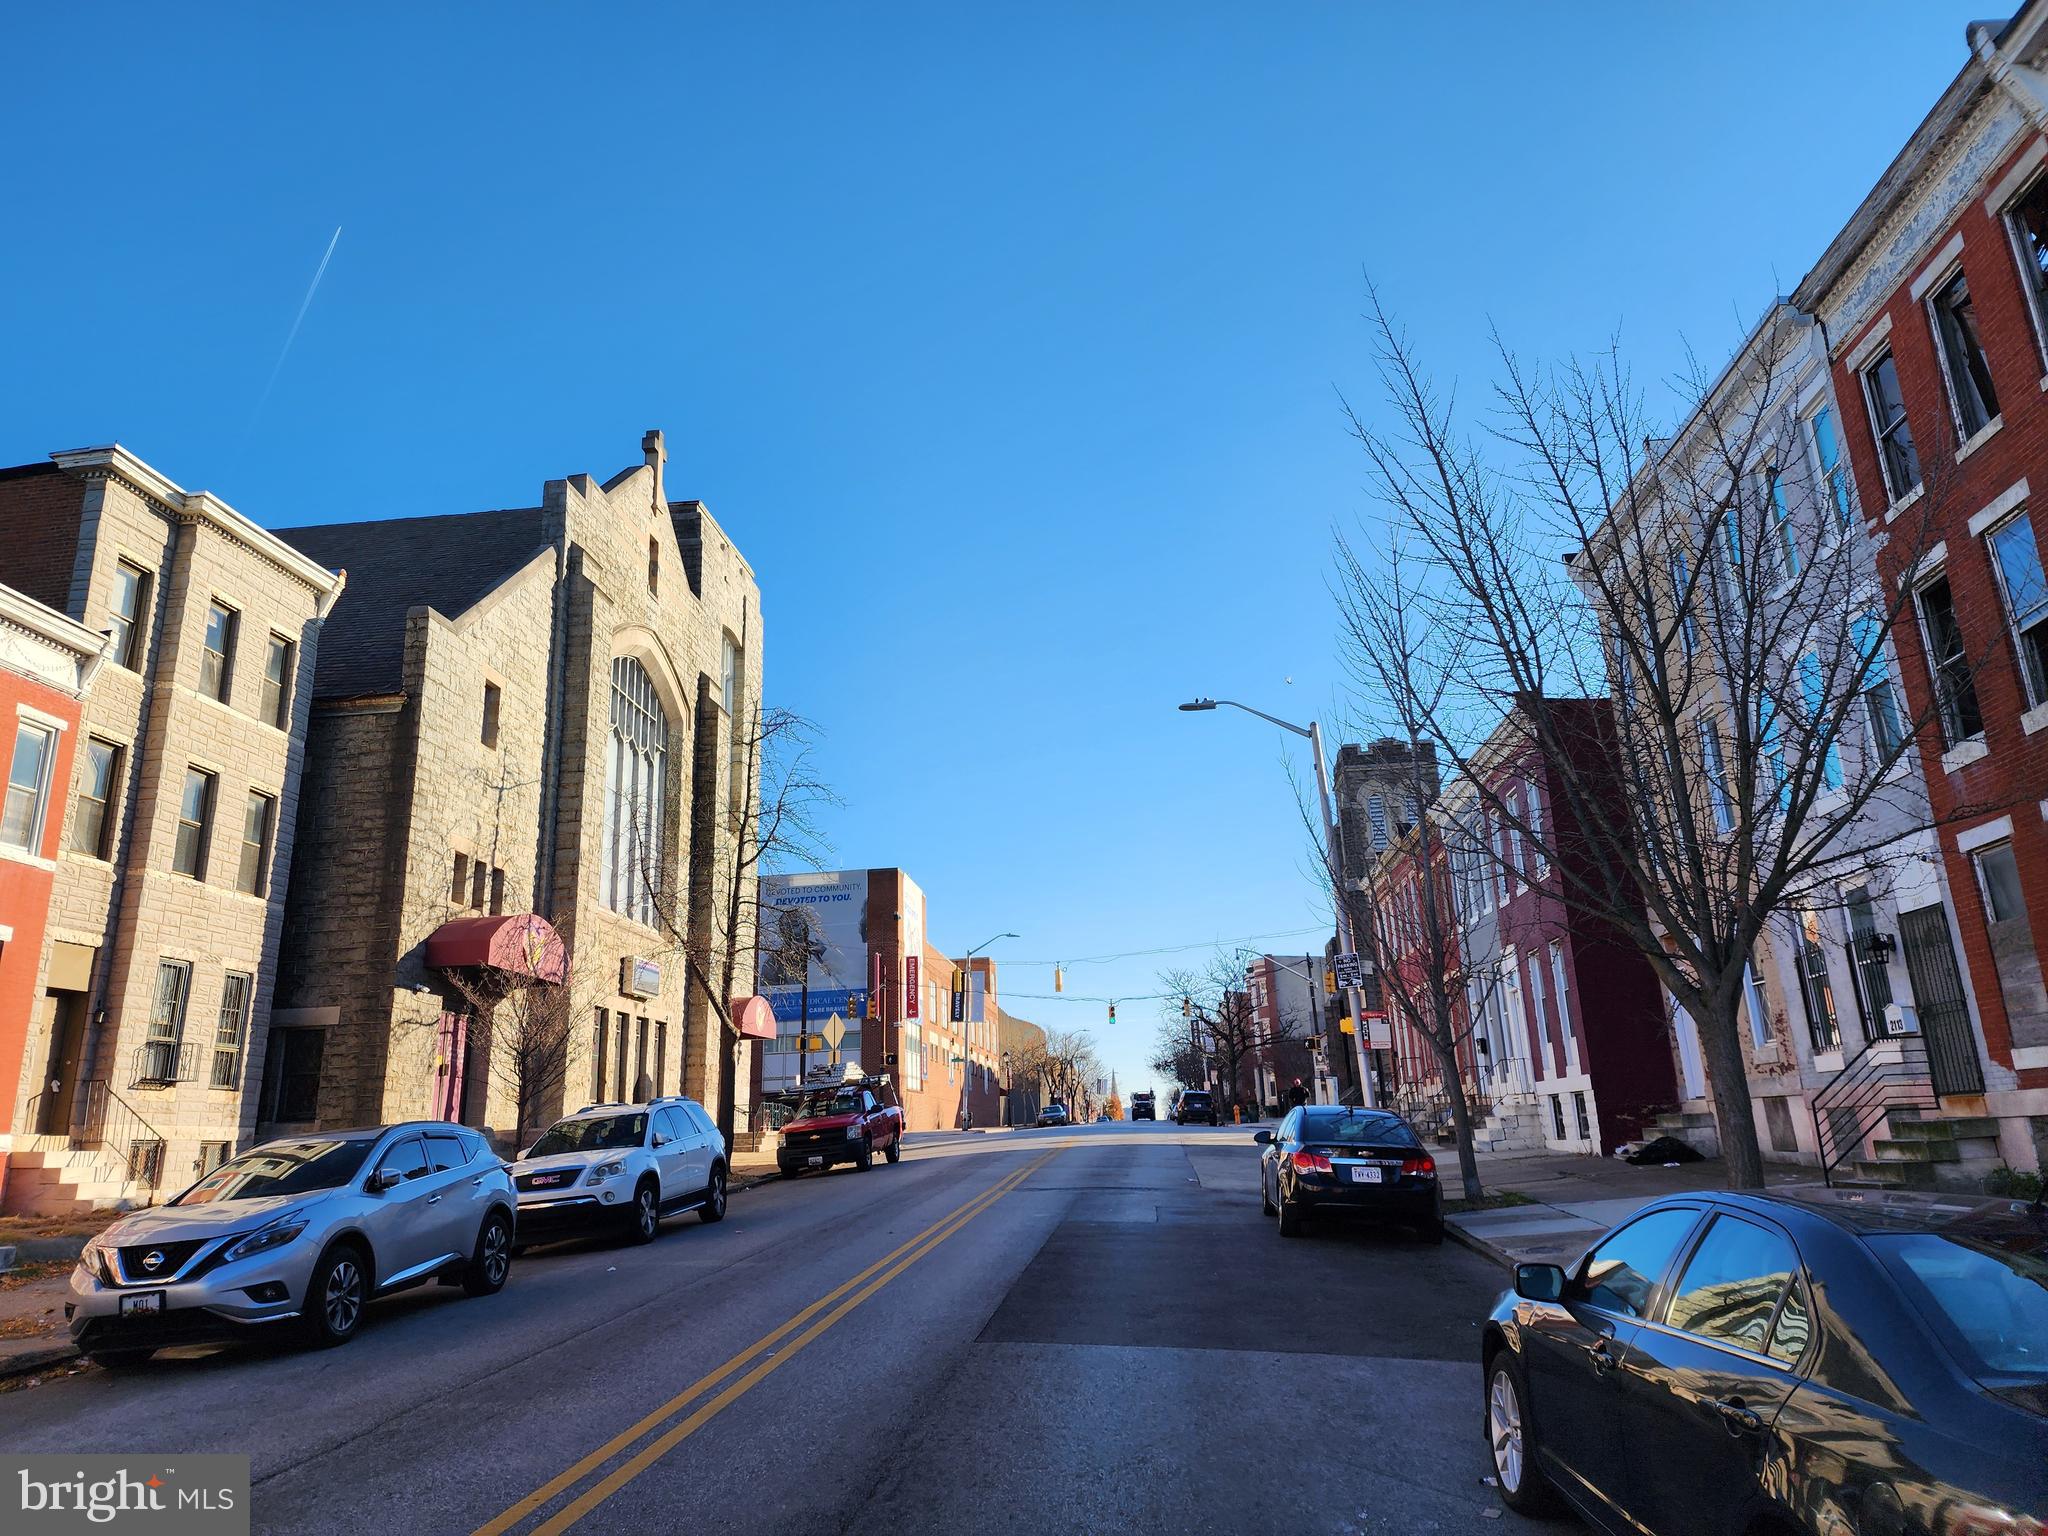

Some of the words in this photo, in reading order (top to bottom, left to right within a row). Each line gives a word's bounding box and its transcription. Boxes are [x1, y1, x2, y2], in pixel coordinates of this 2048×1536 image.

[775, 896, 817, 906] DEVOTED
[818, 895, 830, 903] TO
[832, 894, 852, 902] YOU.
[908, 958, 916, 1005] EMERGENCY
[1889, 1019, 1904, 1031] 2113
[531, 1174, 561, 1185] GMC
